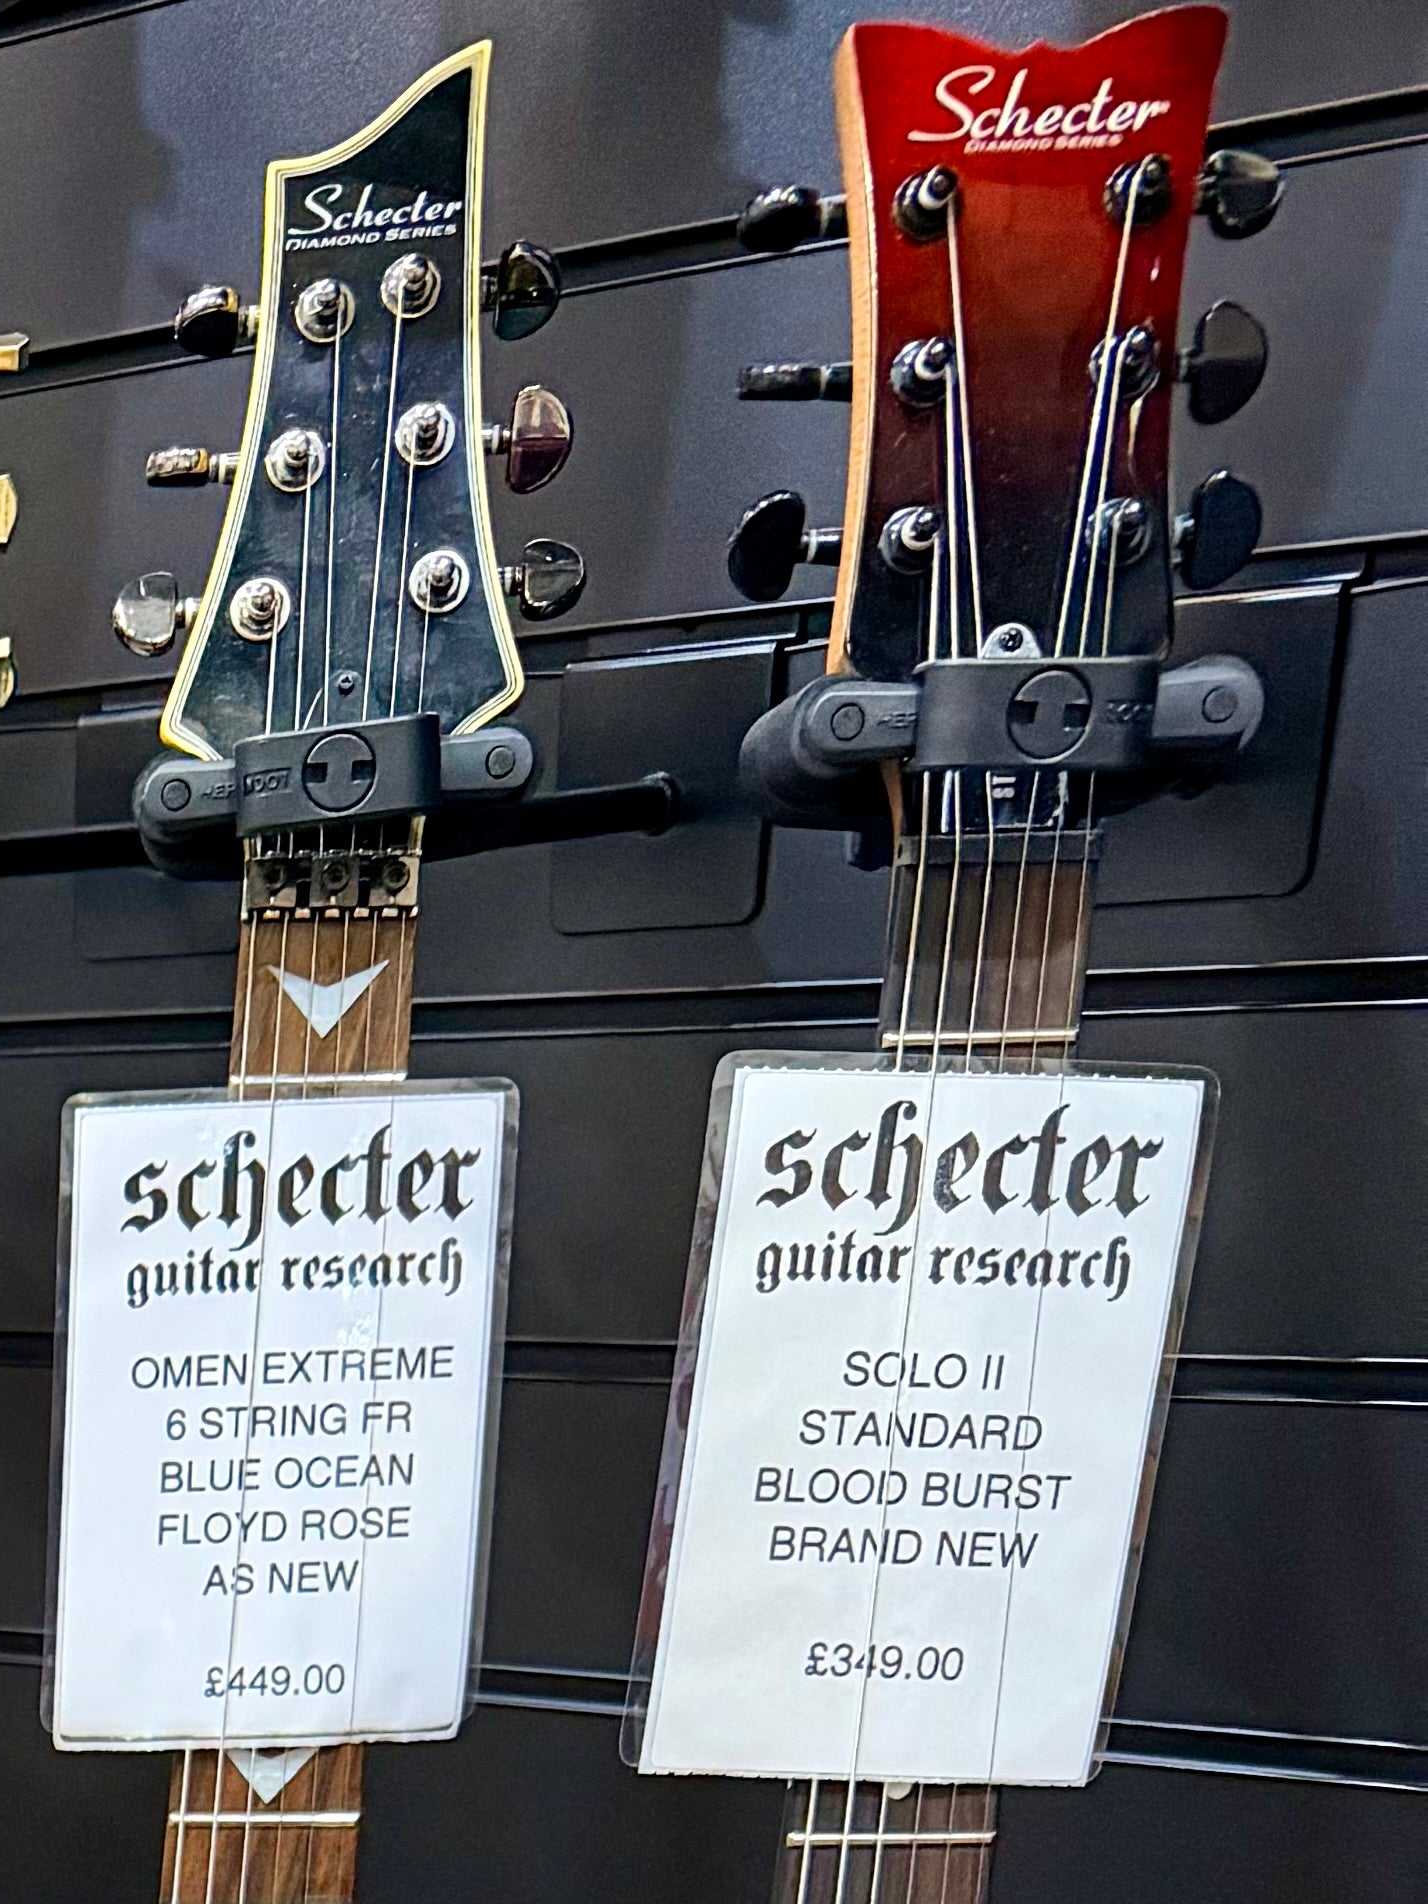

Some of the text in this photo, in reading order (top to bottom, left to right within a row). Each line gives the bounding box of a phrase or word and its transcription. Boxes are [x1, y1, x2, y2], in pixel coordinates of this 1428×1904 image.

[908, 65, 1171, 143] Schecter
[288, 184, 463, 236] Schecter
[285, 224, 457, 251] DIAMOND SERIES
[121, 1124, 481, 1251] schecter
[755, 1100, 1165, 1236] schecter
[127, 1237, 463, 1308] guitar research
[755, 1232, 1132, 1302] guitar research
[131, 1345, 454, 1389] OMEN EXTREME
[842, 1351, 1005, 1391] SOLO II
[166, 1401, 412, 1440] 6 STRING FR
[799, 1409, 1044, 1452] STANDARD
[161, 1453, 414, 1492] BLUE OCEAN
[754, 1467, 1072, 1511] BLOOD BURST
[158, 1507, 411, 1545] FLOYD ROSE
[769, 1526, 1040, 1569] BRAND NEW
[203, 1560, 358, 1596] AS NEW
[204, 1665, 346, 1699] £449.00
[804, 1642, 965, 1682] £349.00
